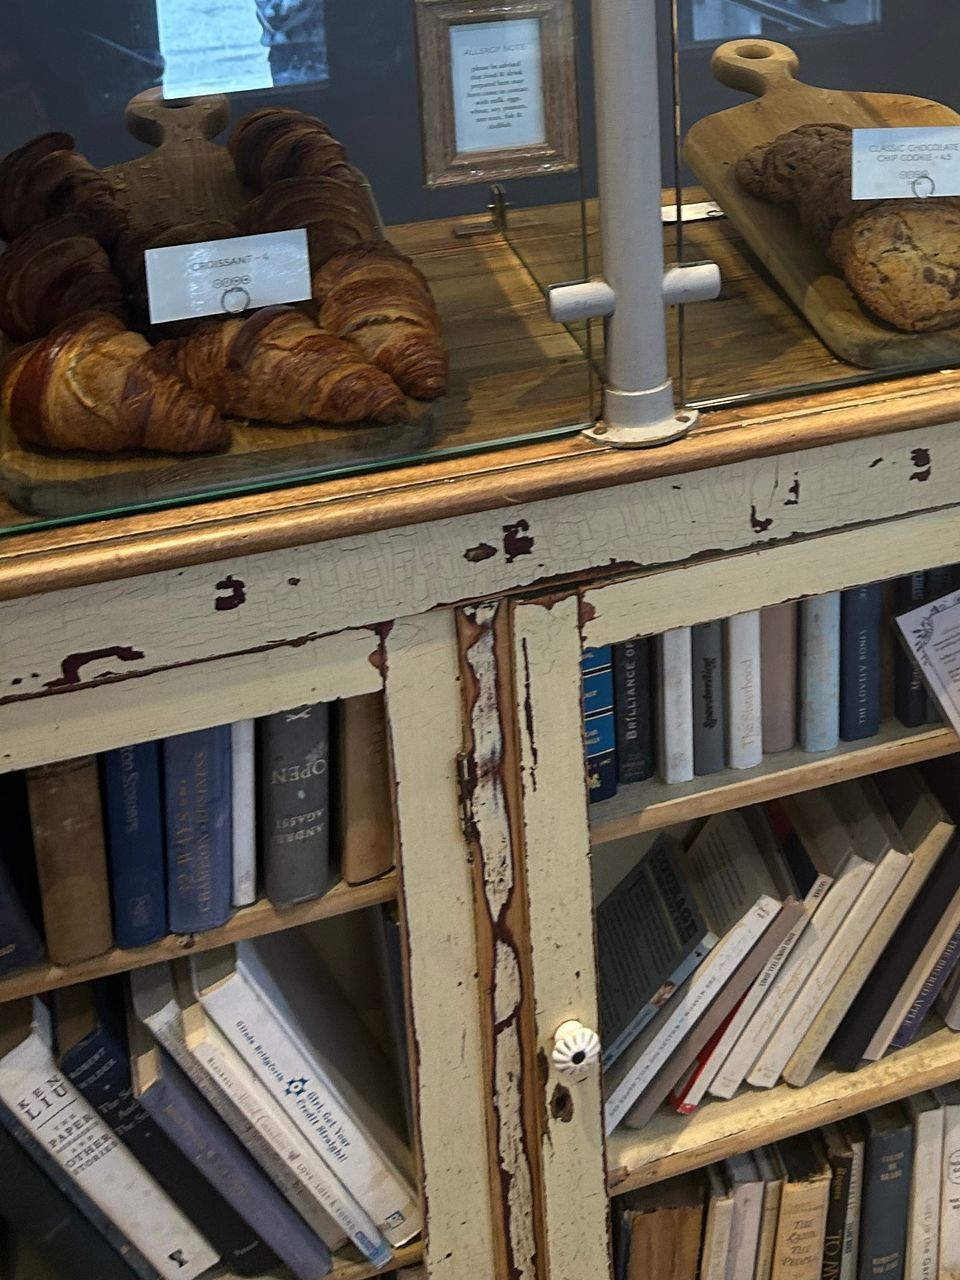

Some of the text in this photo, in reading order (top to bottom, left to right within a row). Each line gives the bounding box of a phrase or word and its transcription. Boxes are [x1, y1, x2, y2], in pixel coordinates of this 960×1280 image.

[868, 143, 960, 153] CLASSIC CHOCOLATE
[876, 153, 933, 162] CHIP COOKIE
[191, 254, 253, 272] CROISSANT
[625, 660, 638, 741] BRILLIANCE
[740, 658, 754, 750] The Sisterhood
[270, 758, 327, 785] OPEN
[271, 822, 326, 845] ANDRE
[276, 808, 325, 829] AGASSI
[254, 1044, 285, 1083] Bridgforth
[17, 1073, 61, 1111] KEN
[24, 1082, 69, 1121] LIU
[48, 1113, 95, 1149] PAPER
[54, 1113, 76, 1131] THE
[296, 1098, 349, 1164] Credit Straight!
[306, 1090, 351, 1148] Girl, Get Your
[64, 1133, 112, 1168] OTHER
[70, 1140, 121, 1176] STORIES
